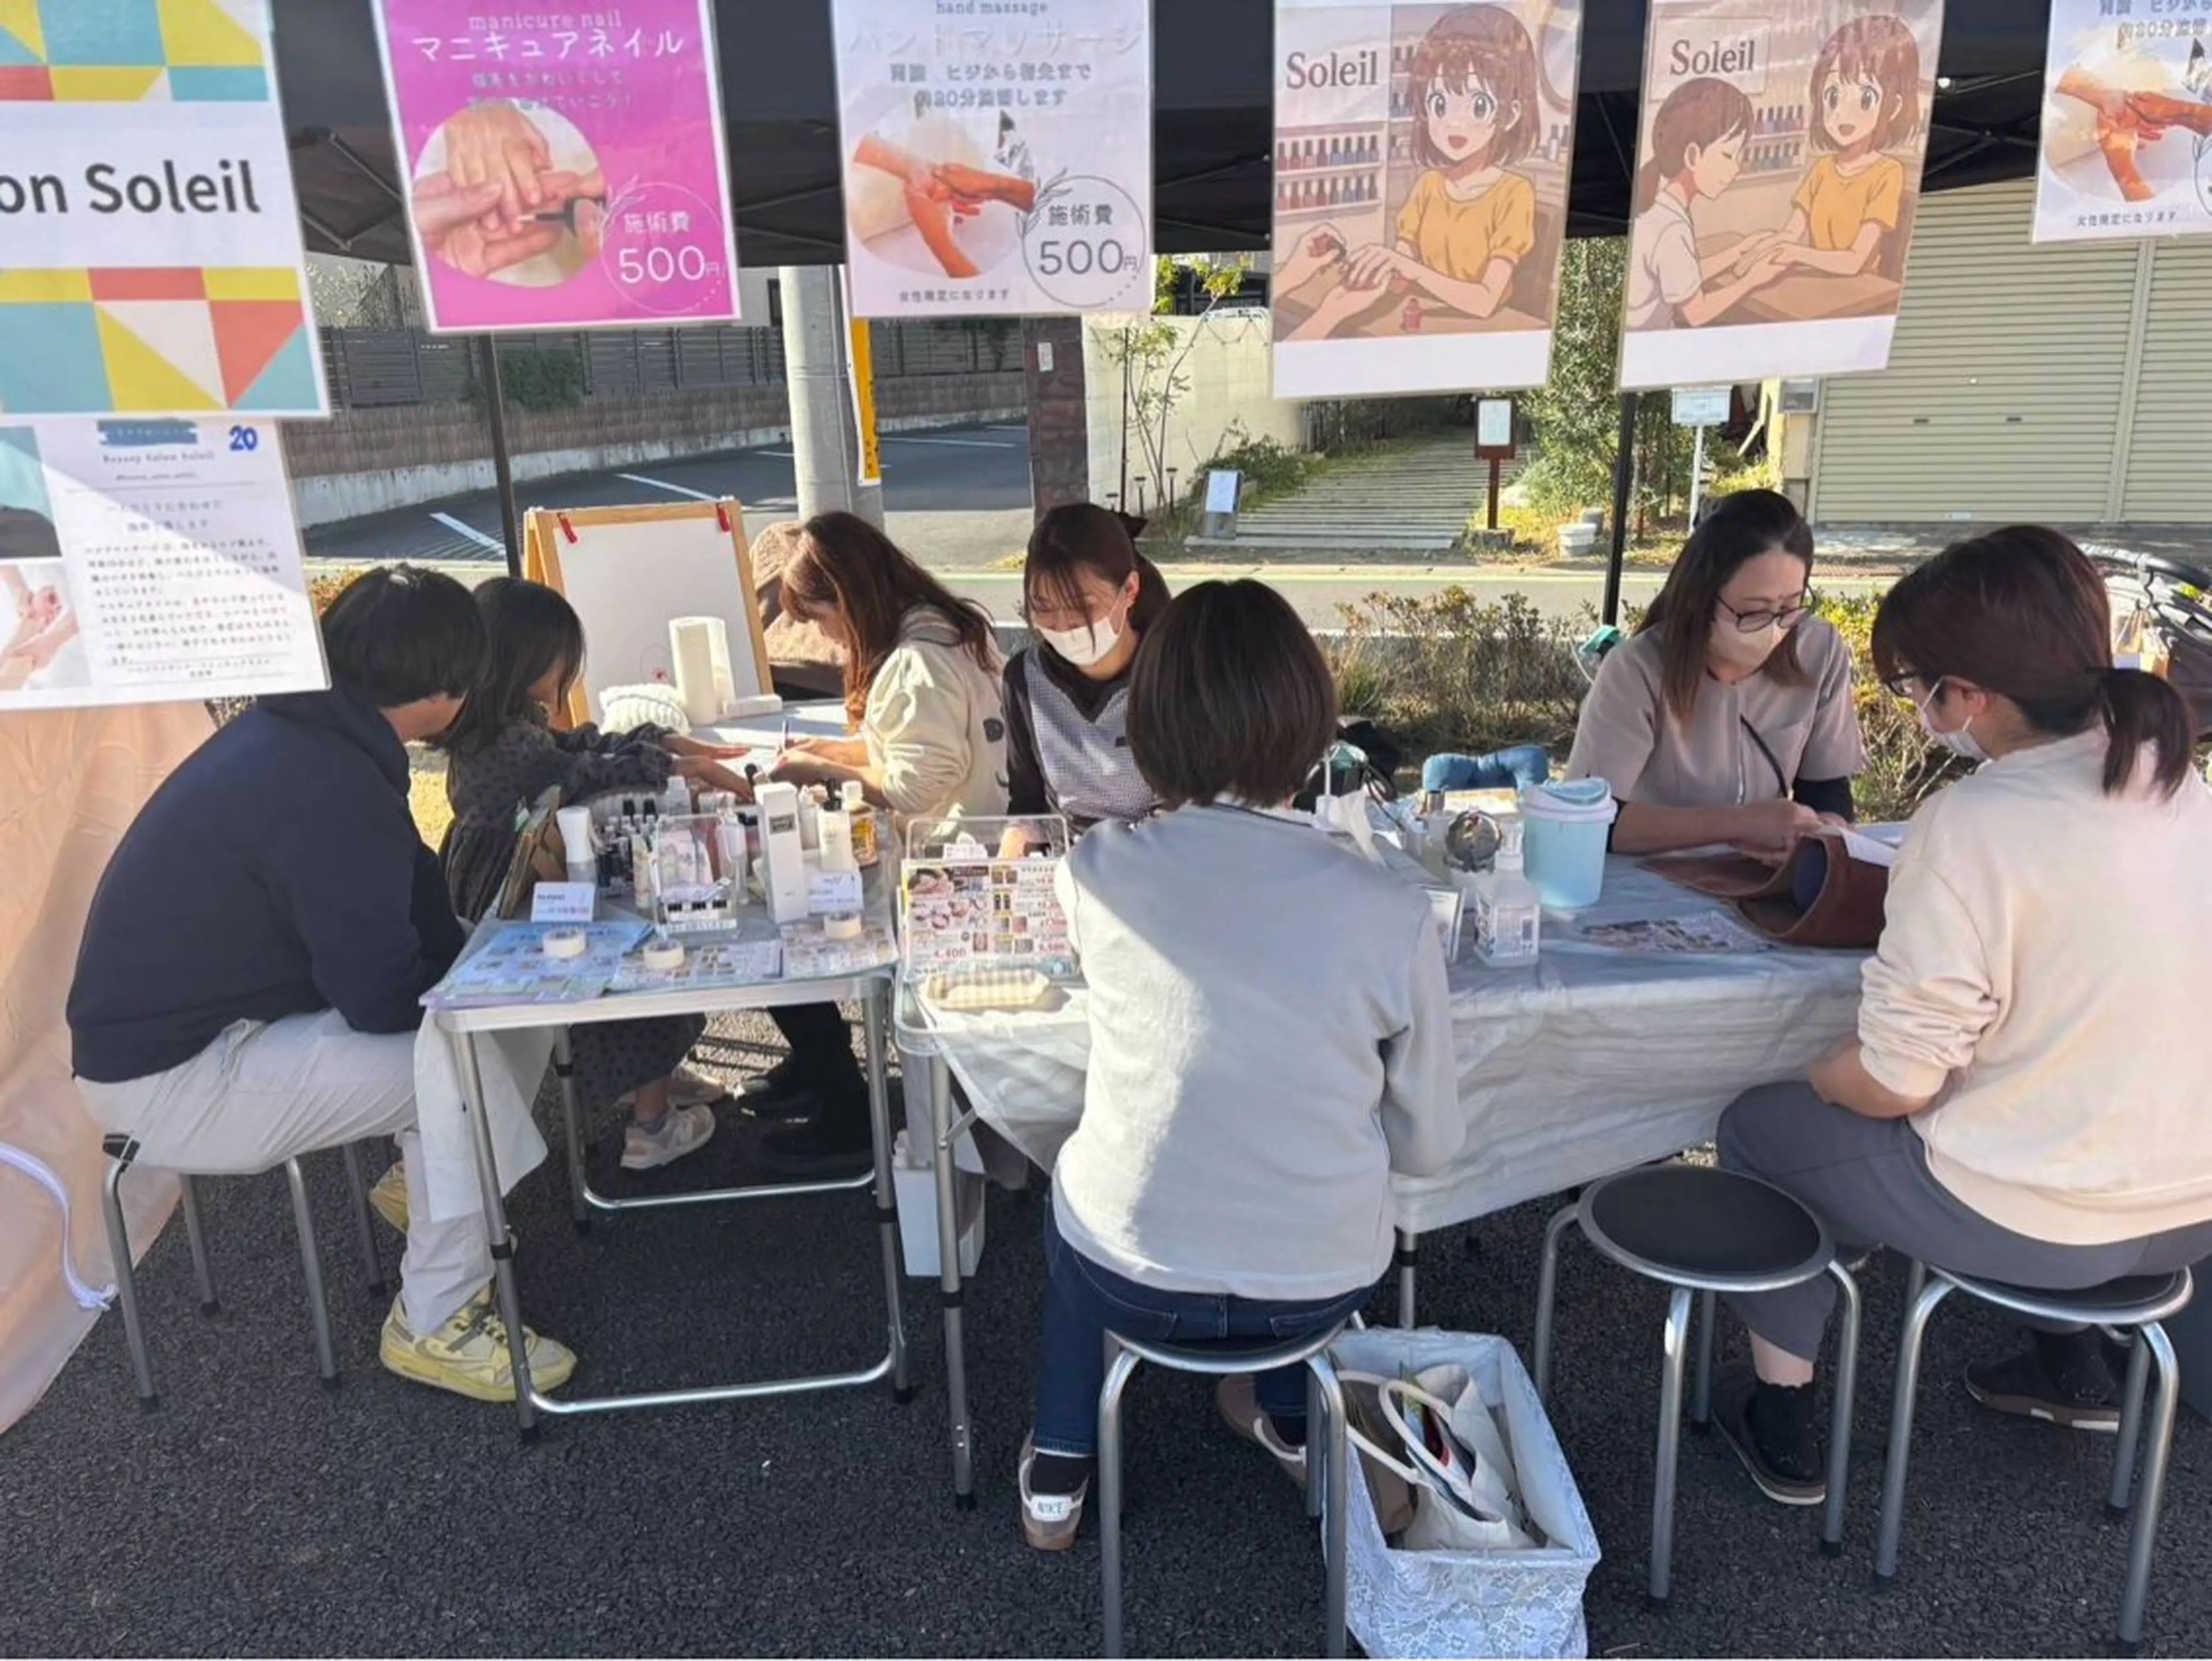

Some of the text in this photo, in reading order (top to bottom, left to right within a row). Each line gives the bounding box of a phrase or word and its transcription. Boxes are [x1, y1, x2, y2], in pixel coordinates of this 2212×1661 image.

[468, 9, 623, 30] manicure nail
[980, 2, 1048, 16] massage
[411, 28, 684, 60] マニキュアネイル
[849, 21, 1144, 57] ハンドマッサージ
[1286, 50, 1378, 89] Soleil
[1670, 39, 1755, 76] Soleil
[85, 159, 262, 213] Soleil
[623, 210, 689, 234] 施術費
[1048, 203, 1113, 226] 施術費
[229, 425, 257, 451] 20
